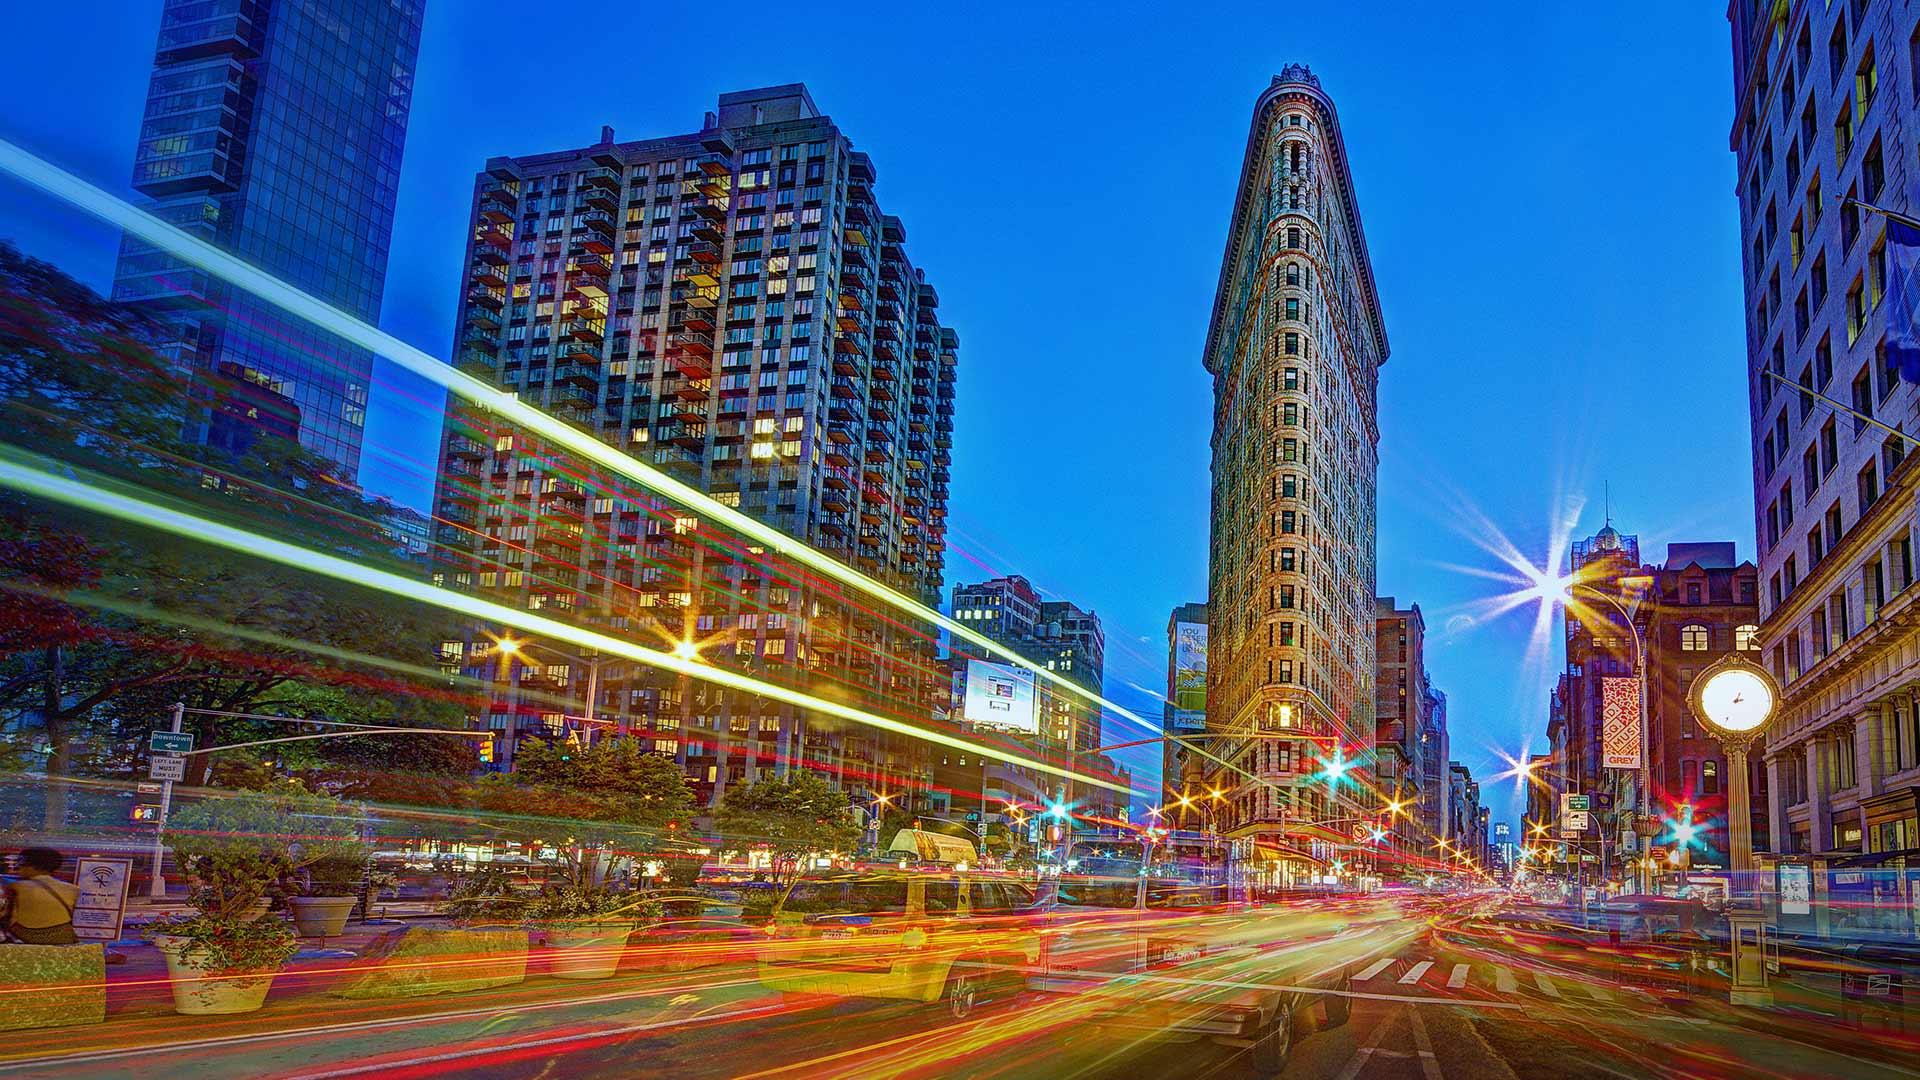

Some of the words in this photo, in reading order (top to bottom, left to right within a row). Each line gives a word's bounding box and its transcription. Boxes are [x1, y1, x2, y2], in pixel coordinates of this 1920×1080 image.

[1182, 627, 1199, 635] YOU
[153, 733, 191, 742] Downtown
[1608, 756, 1634, 765] GREY
